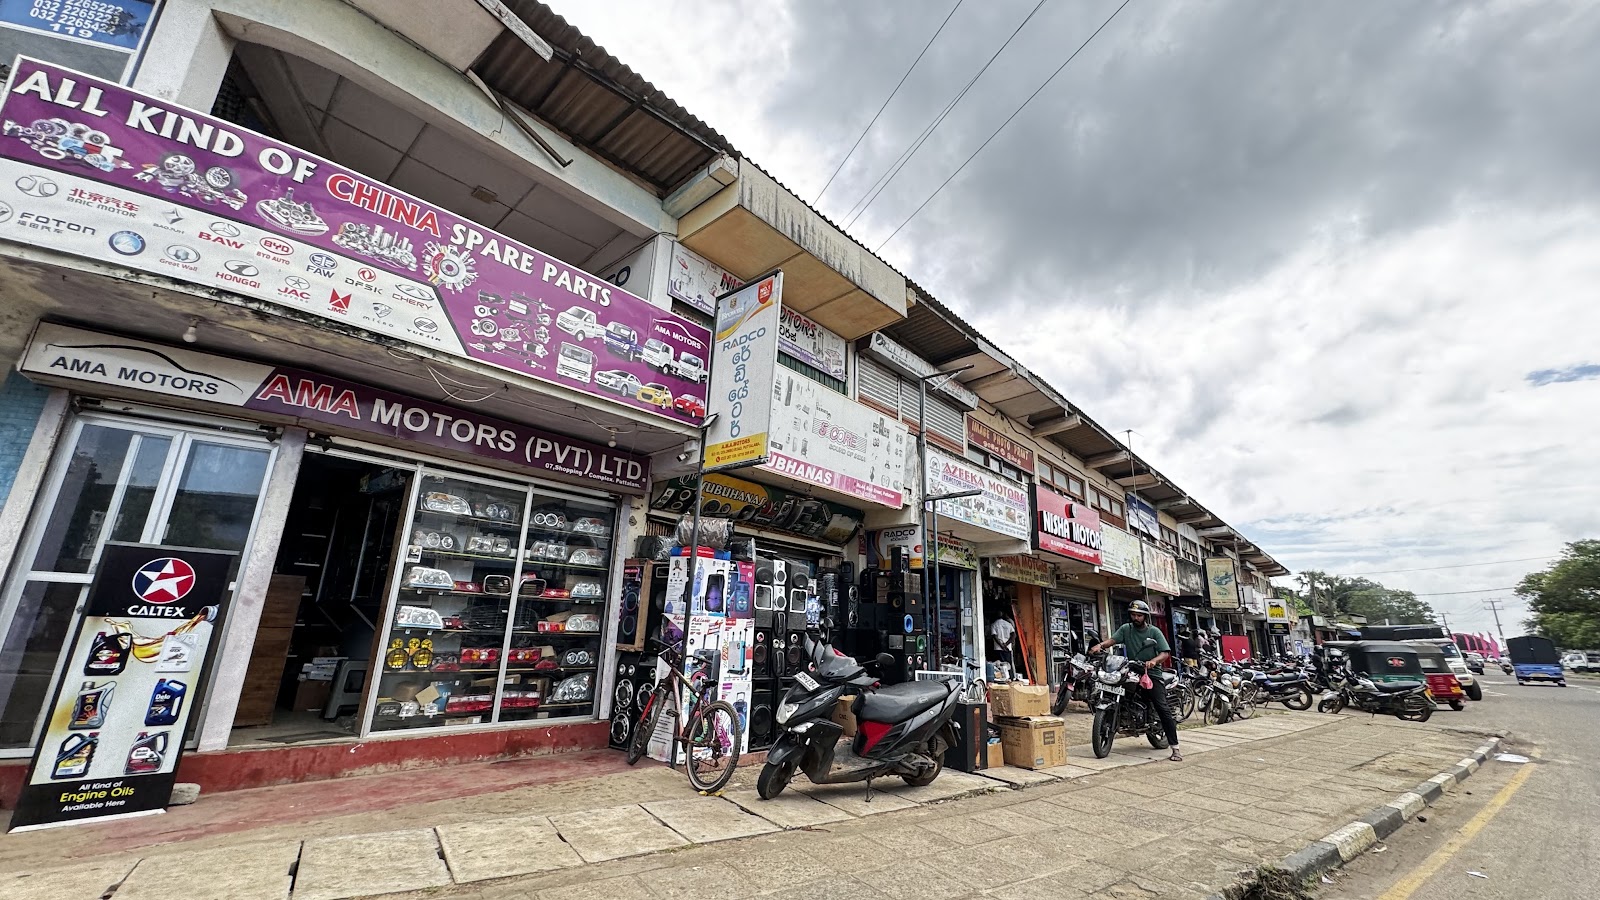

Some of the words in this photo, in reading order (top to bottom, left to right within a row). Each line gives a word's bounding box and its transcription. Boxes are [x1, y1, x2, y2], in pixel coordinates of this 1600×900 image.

[30, 8, 57, 21] 032
[49, 23, 93, 38] 119
[12, 70, 108, 118] ALL
[125, 100, 245, 159] KIND
[258, 147, 318, 185] OF
[326, 173, 441, 238] CHINA
[450, 223, 534, 275] SPARE
[541, 261, 612, 307] PARTS
[66, 196, 93, 208] BAIC
[99, 203, 138, 219] MOTOR
[20, 212, 97, 236] FOTON
[198, 231, 245, 250] BAW
[263, 240, 290, 254] BYD
[159, 258, 181, 269] Great
[181, 263, 199, 272] Wall
[306, 265, 335, 279] FAW
[215, 271, 261, 289] HONGQI
[344, 277, 383, 295] DFSK
[277, 286, 311, 300] JAC
[392, 293, 433, 310] CHERY
[327, 307, 348, 315] JMC
[655, 324, 671, 337] AMA
[672, 331, 702, 350] MOTORS
[722, 326, 766, 352] RADCO
[49, 356, 107, 376] AMA
[117, 367, 219, 396] MOTORS
[255, 374, 361, 422] AMA
[370, 398, 517, 453] MOTORS
[525, 435, 594, 475] (PVT)
[599, 453, 647, 484] LTD.
[818, 421, 829, 437] 5
[829, 425, 859, 449] CORE
[767, 455, 833, 485] UBHANAS
[943, 462, 985, 489] AZEEKA
[1042, 509, 1071, 540] NISHA
[884, 528, 916, 539] RADCO
[127, 605, 186, 618] CALTEX
[1270, 610, 1284, 618] eni
[155, 693, 171, 701] Delo
[60, 790, 107, 803] Engine
[111, 786, 135, 797] Oils
[78, 783, 91, 791] All
[92, 781, 112, 790] Kind
[61, 801, 104, 812] Available
[105, 800, 126, 808] Here
